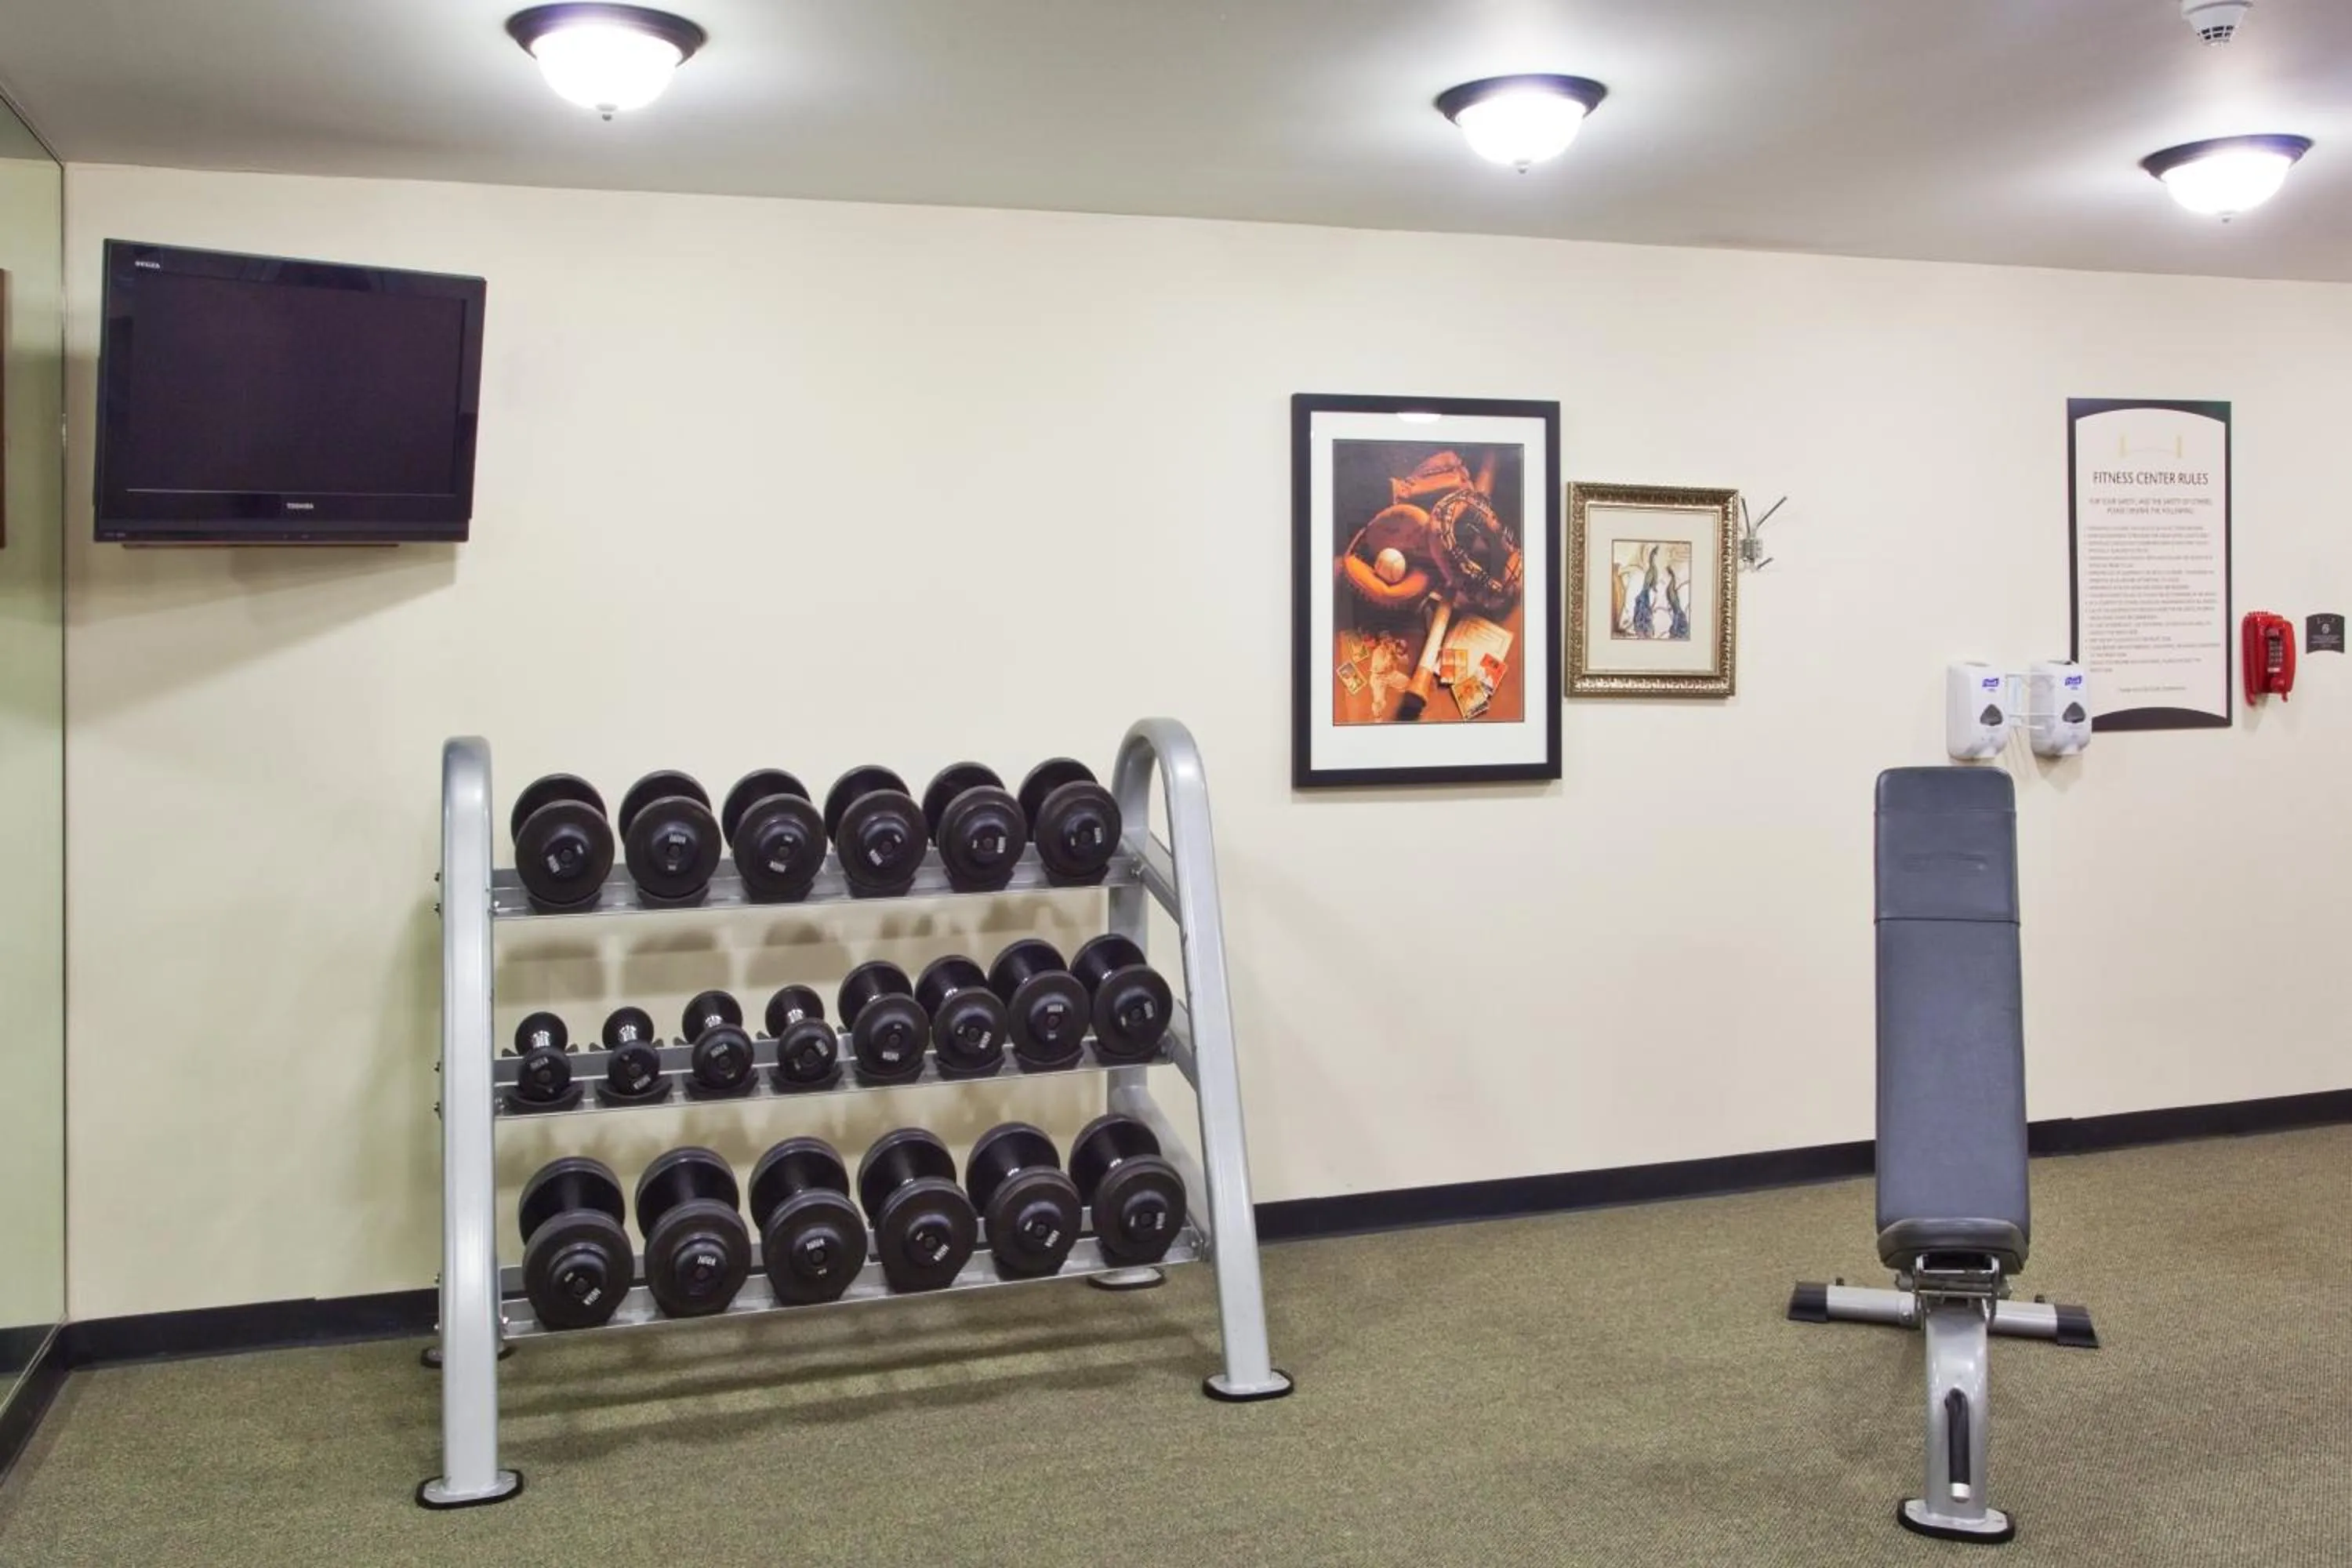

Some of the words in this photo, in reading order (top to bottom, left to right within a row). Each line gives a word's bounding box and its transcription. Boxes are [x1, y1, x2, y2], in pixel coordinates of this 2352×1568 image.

[2092, 471, 2132, 485] FITNESS
[2136, 471, 2176, 485] CENTER
[2177, 472, 2209, 485] RULES
